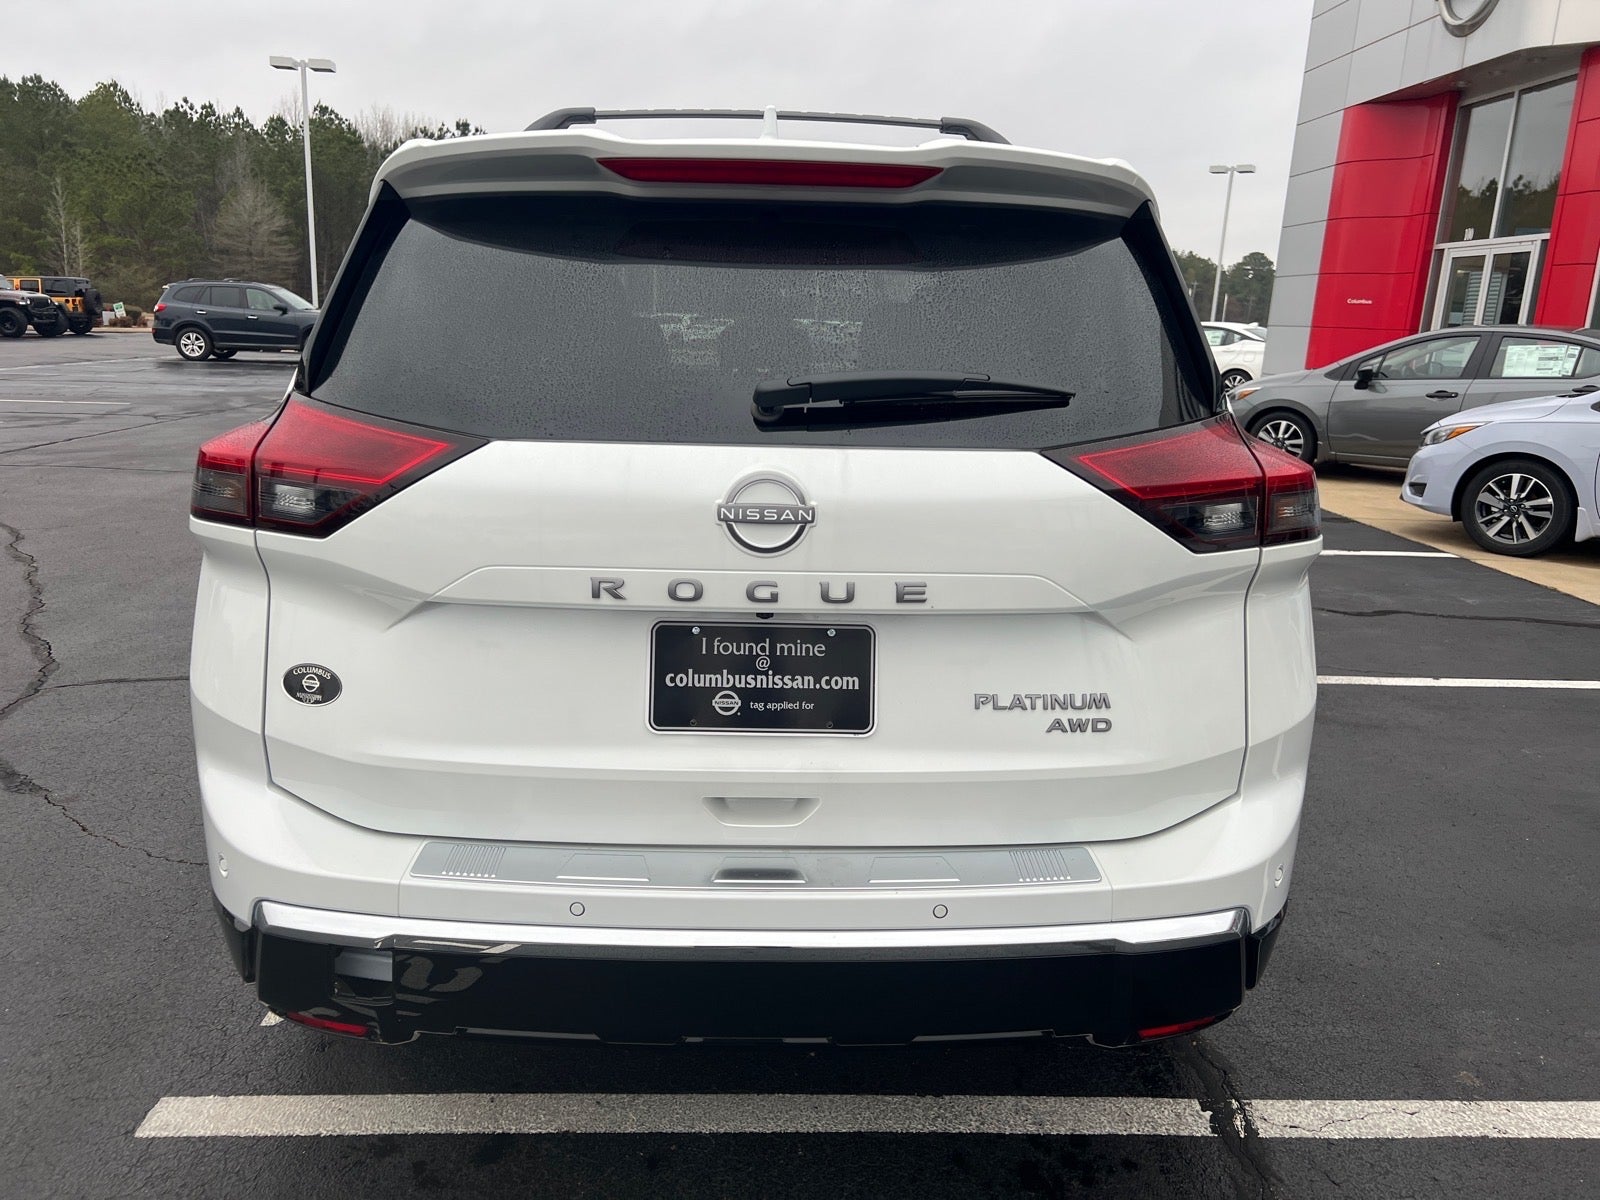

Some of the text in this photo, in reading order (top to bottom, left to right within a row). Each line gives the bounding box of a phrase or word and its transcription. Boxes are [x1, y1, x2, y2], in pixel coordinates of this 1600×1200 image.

[720, 506, 813, 522] NISSAN
[590, 576, 928, 604] ROGUE
[701, 637, 826, 657] I found mine
[755, 655, 771, 671] @
[293, 667, 331, 679] COLUMBUS
[665, 668, 860, 690] columbusnissan.com
[749, 700, 815, 711] tag applied for
[974, 692, 1112, 711] PLATINUM
[1045, 717, 1113, 733] AWD
